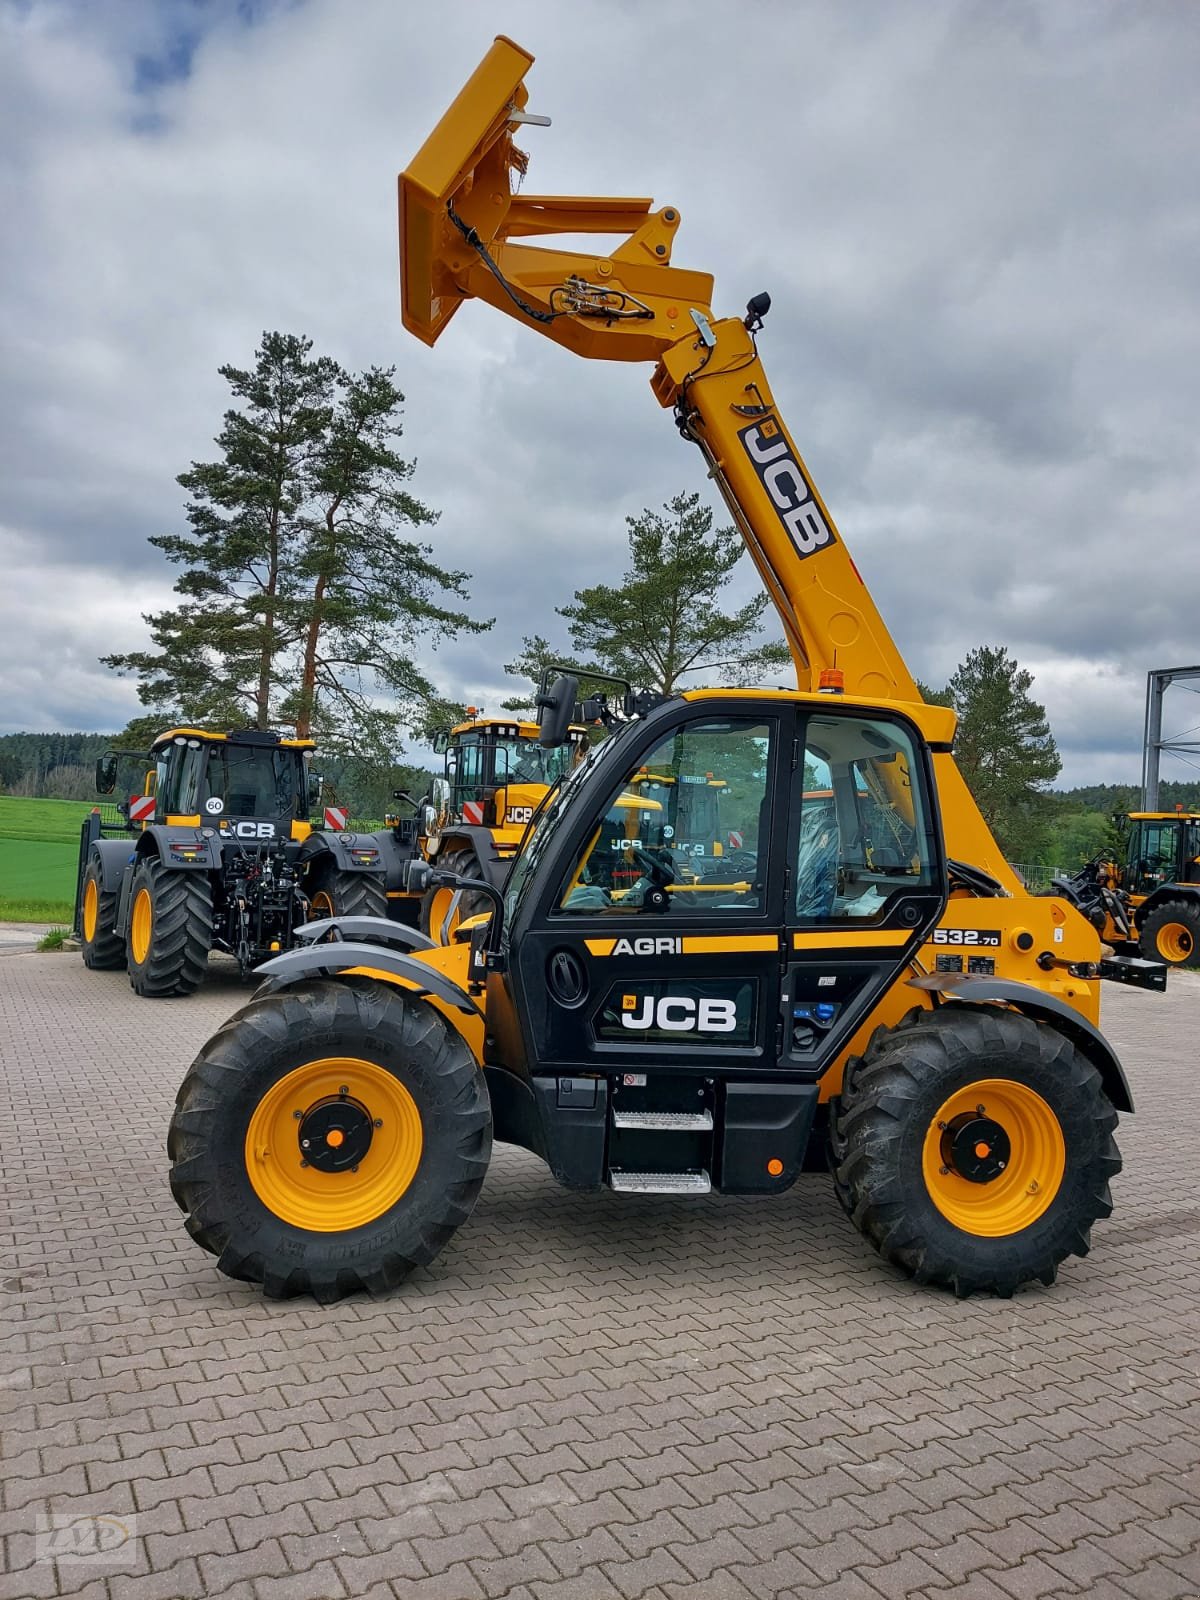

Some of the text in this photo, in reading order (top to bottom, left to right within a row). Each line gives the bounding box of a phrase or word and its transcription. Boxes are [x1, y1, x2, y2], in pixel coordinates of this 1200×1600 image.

[744, 427, 830, 554] JCB
[506, 807, 533, 824] JCB
[611, 839, 643, 850] JCB
[612, 937, 682, 956] AGRI
[621, 995, 737, 1032] JCB
